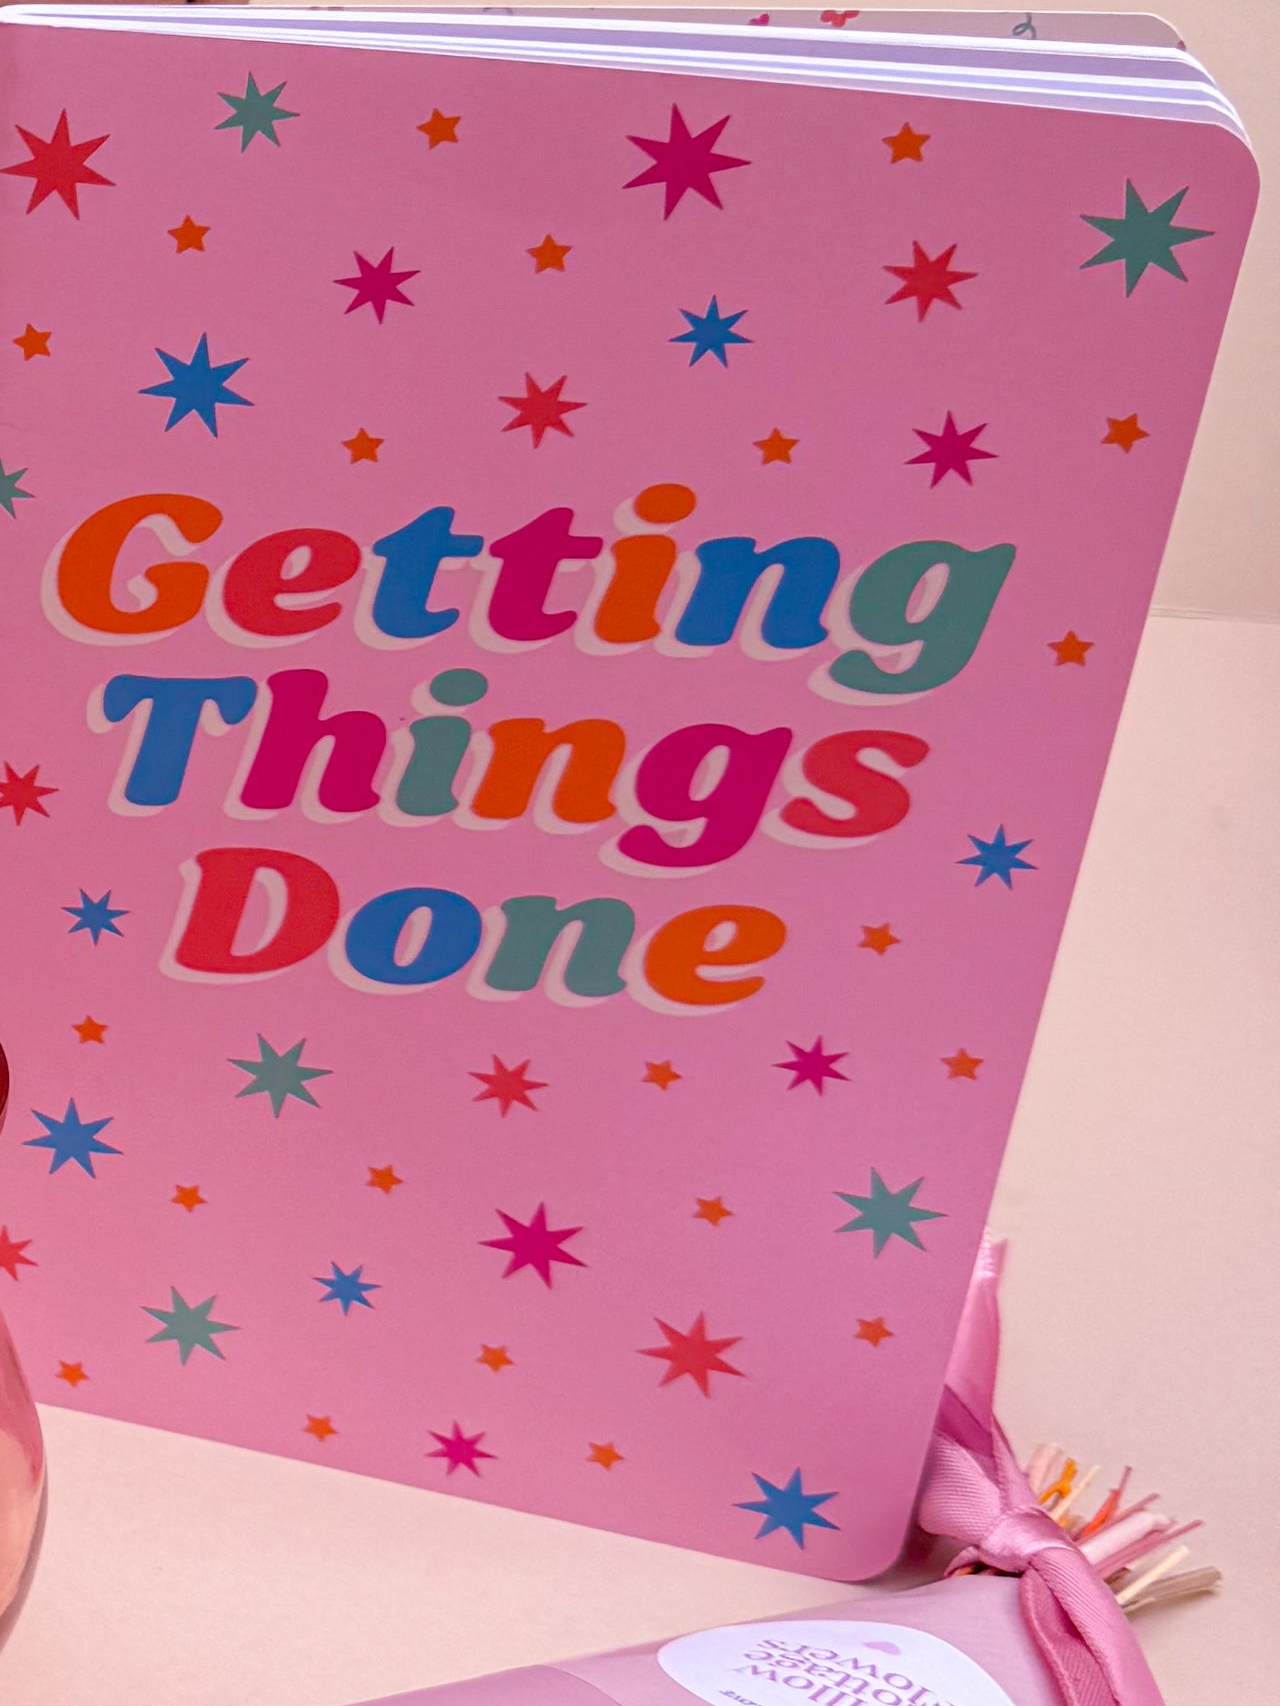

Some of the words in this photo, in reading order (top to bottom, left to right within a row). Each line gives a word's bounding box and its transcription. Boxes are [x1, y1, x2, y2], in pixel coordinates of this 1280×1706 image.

[55, 483, 1017, 697] Getting
[102, 667, 930, 869] Things
[172, 846, 788, 1008] Done
